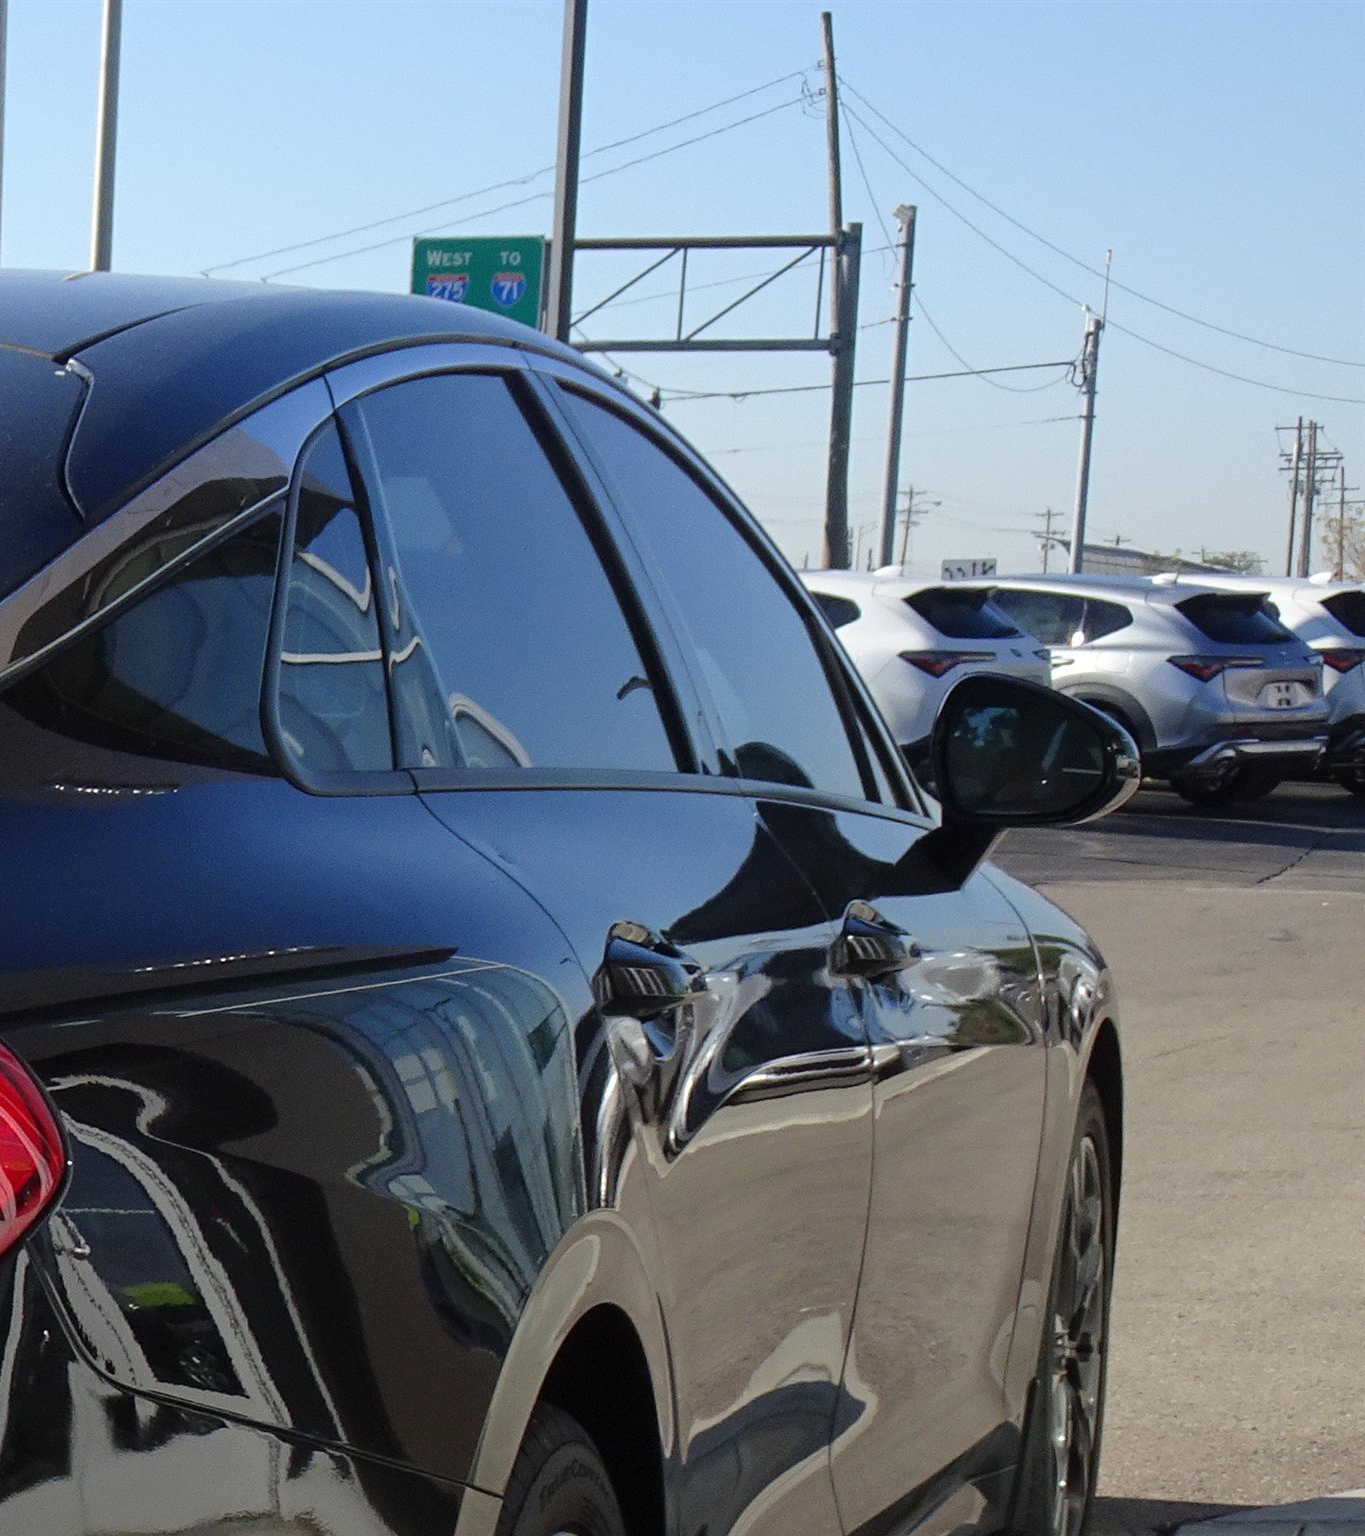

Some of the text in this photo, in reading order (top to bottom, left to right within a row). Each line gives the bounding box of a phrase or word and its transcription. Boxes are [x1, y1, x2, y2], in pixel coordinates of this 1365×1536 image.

[426, 249, 521, 266] WEST TO
[431, 281, 519, 301] 275 71
